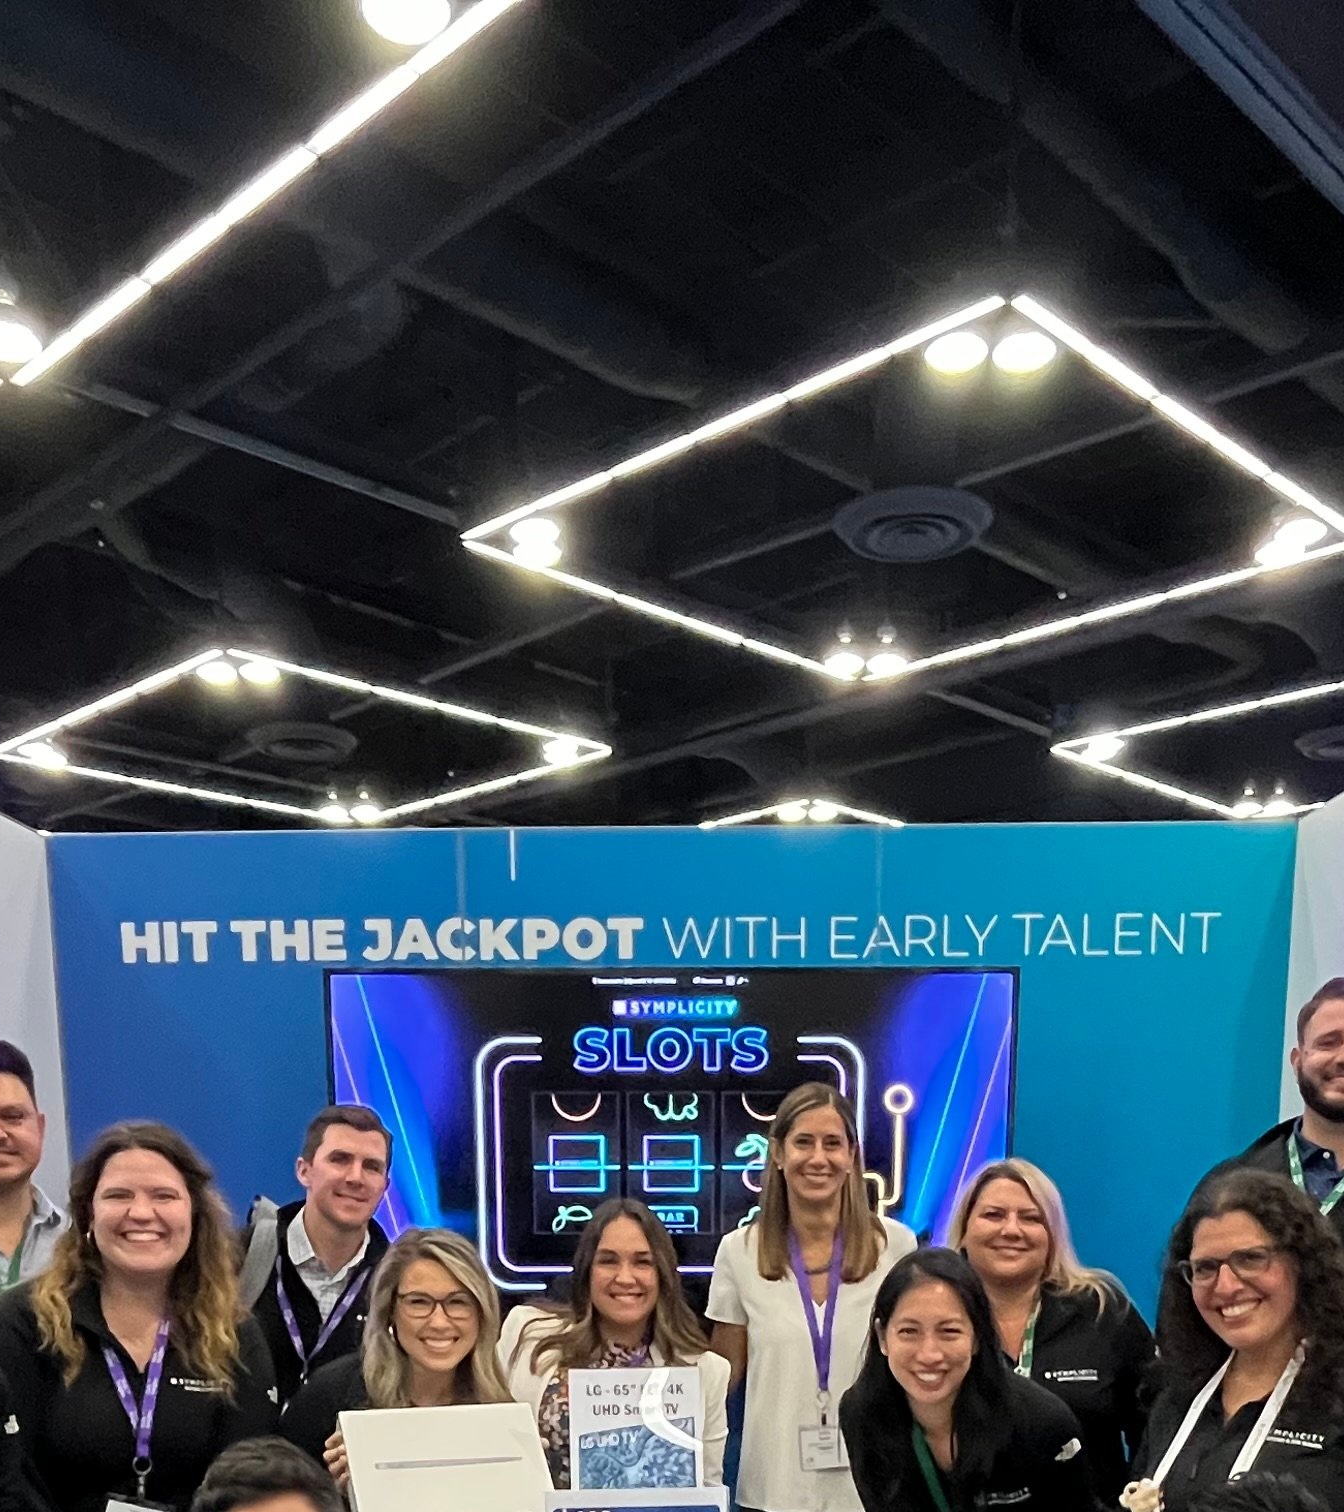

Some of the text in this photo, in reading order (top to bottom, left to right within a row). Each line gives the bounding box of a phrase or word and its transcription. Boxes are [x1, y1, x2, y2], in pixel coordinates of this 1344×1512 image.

[120, 911, 1222, 964] HIT THE JACKPOT WITH EARLY TALENT
[630, 999, 738, 1016] SYMPLICITY
[573, 1026, 769, 1073] SLOTS
[586, 1384, 602, 1397] LG
[666, 1383, 684, 1396] 4K
[592, 1404, 620, 1416] UHD
[664, 1402, 679, 1415] TV
